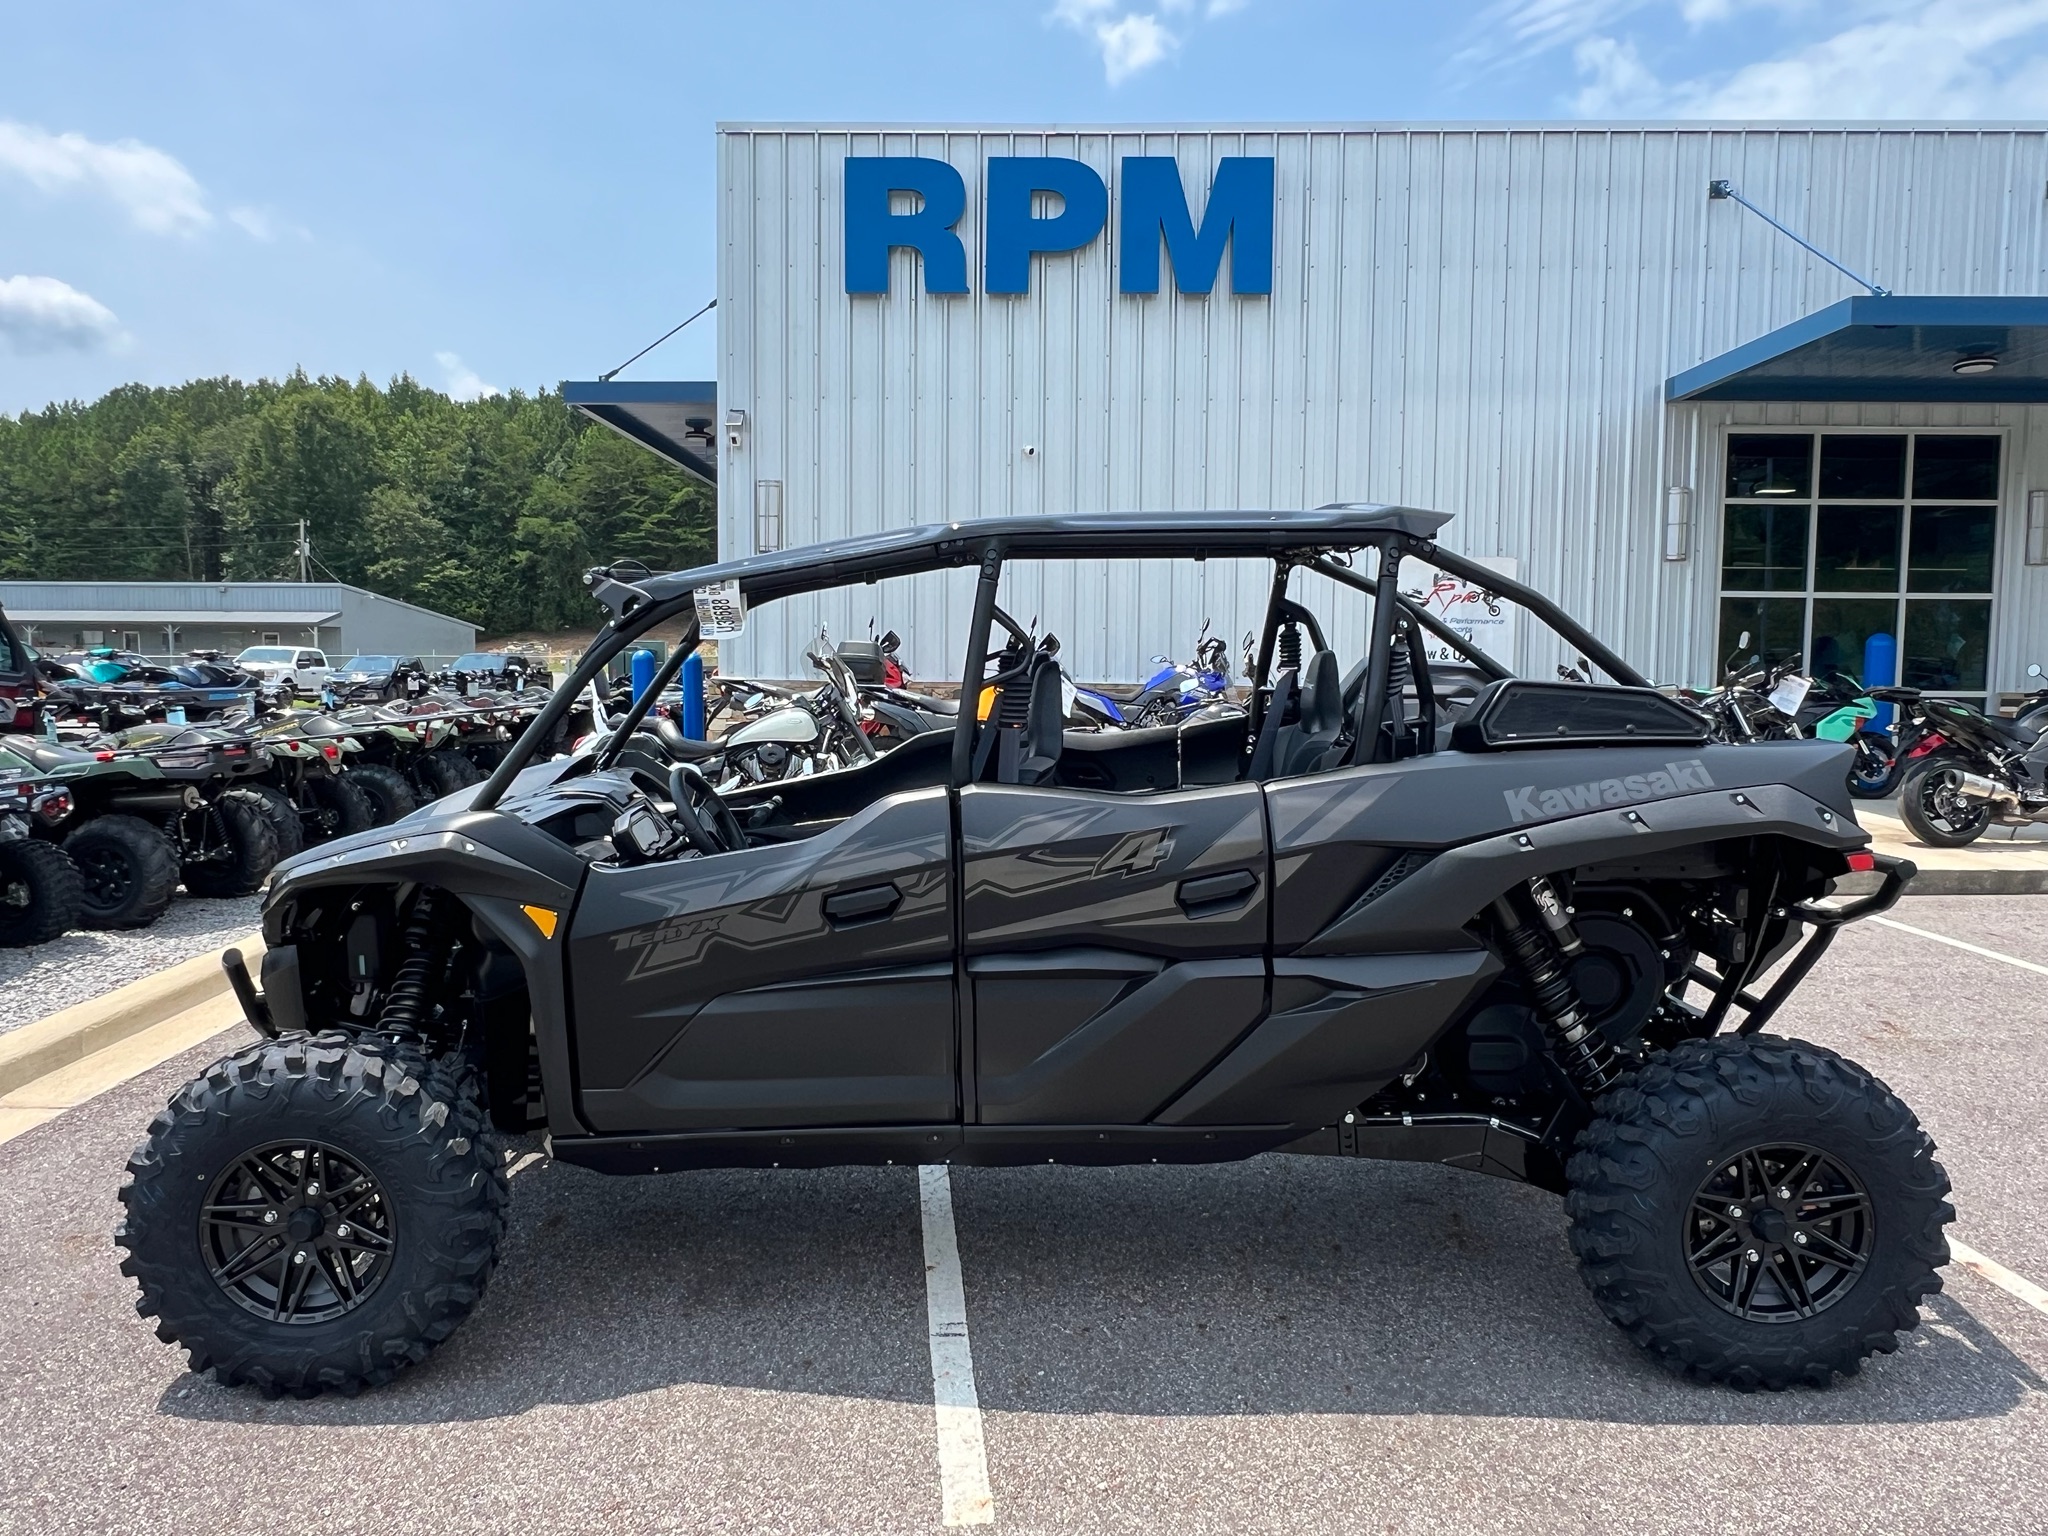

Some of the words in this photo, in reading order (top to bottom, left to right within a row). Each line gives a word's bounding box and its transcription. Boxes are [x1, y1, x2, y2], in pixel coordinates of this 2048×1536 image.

[844, 156, 1275, 294] RPM
[1449, 617, 1505, 625] Performance
[1503, 759, 1715, 823] Kawasaki
[1093, 824, 1175, 878] 4
[609, 914, 729, 951] TERYX
